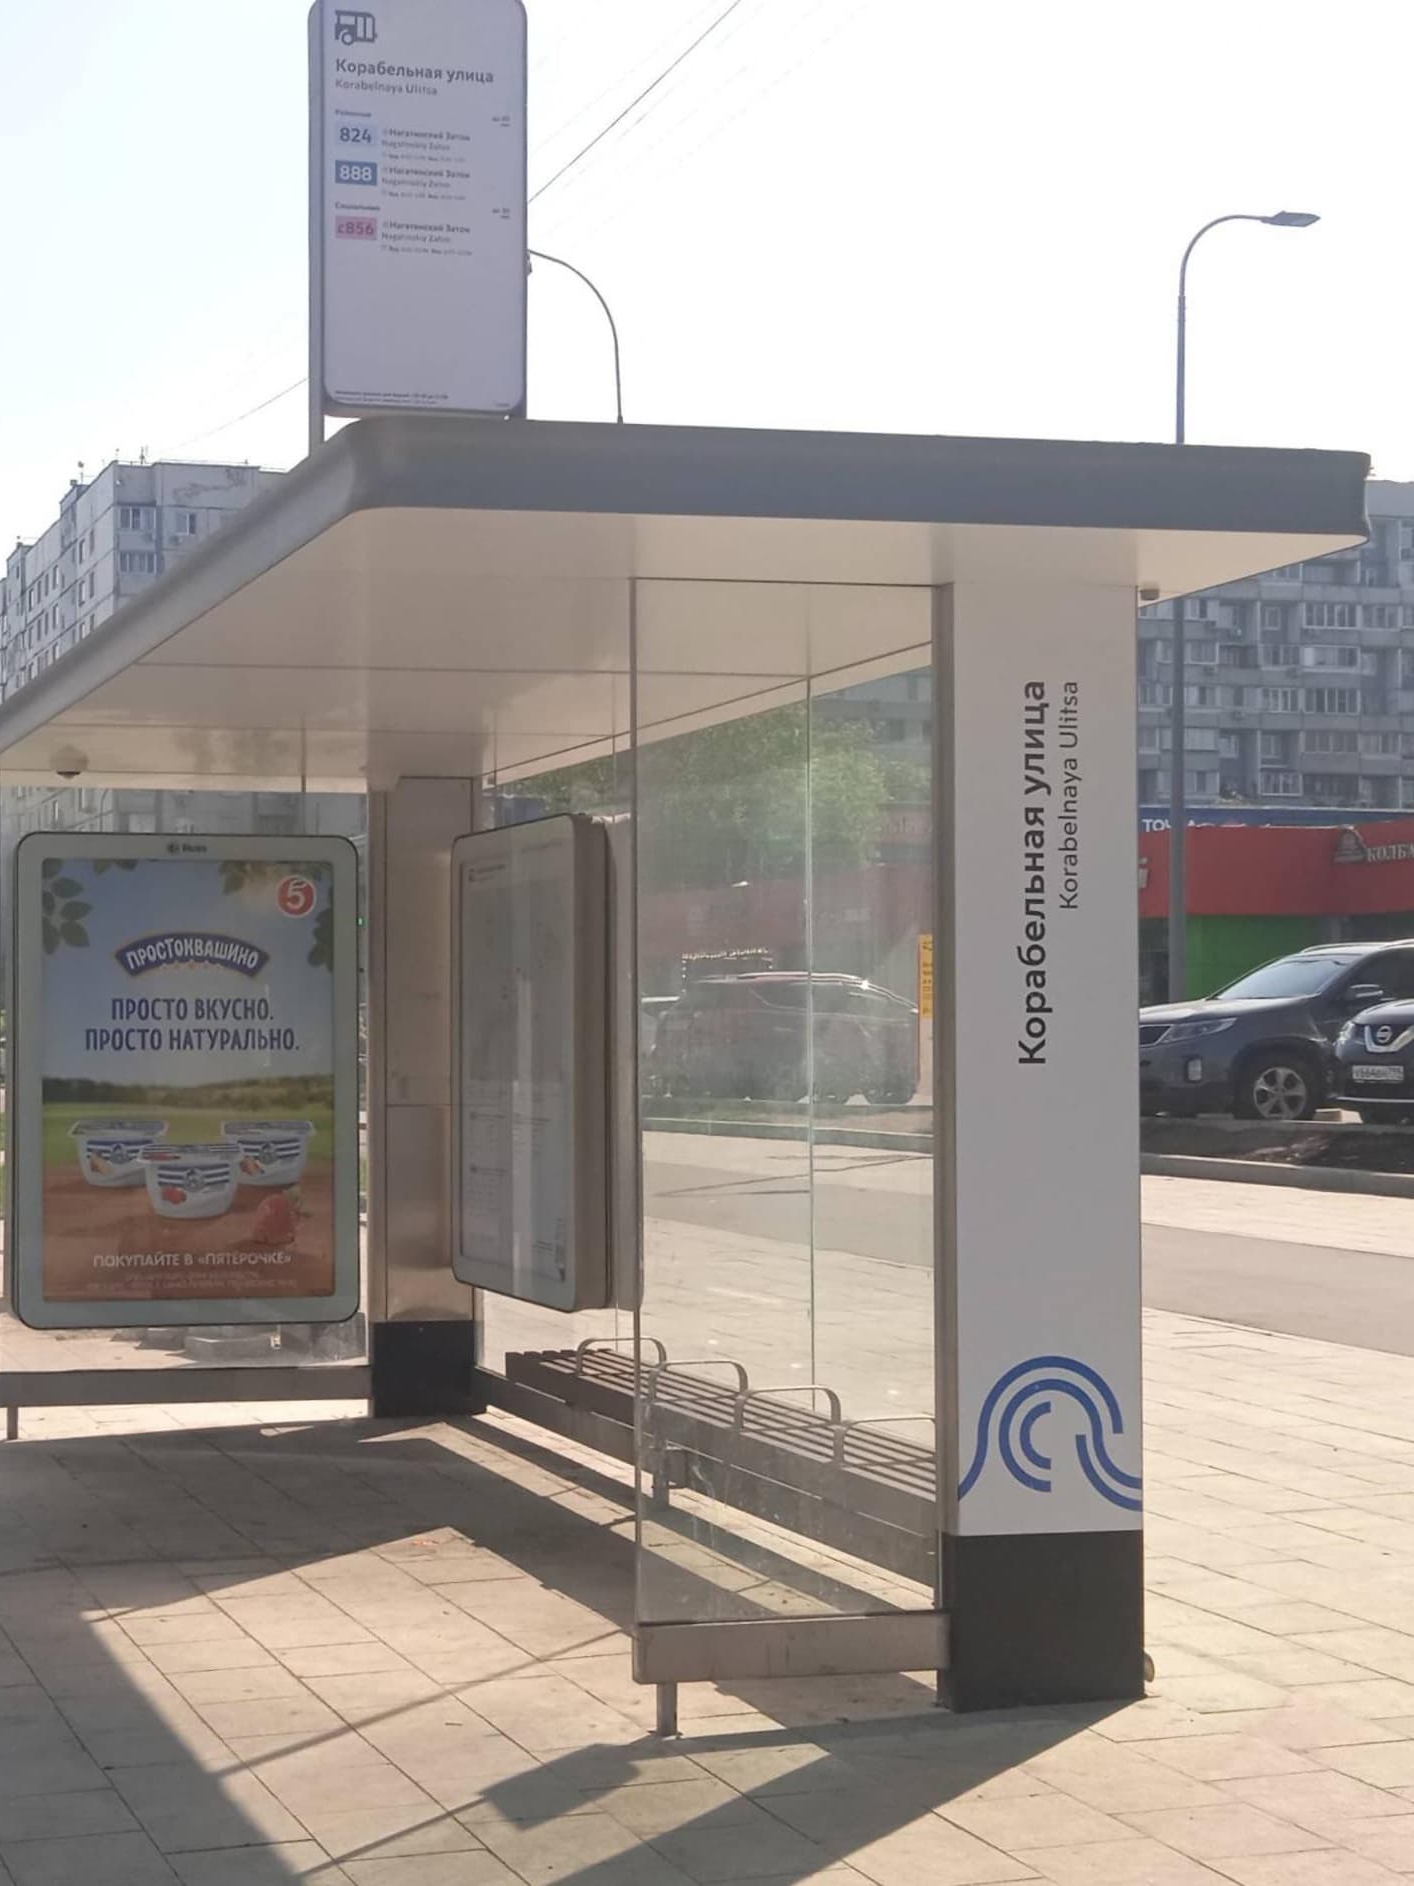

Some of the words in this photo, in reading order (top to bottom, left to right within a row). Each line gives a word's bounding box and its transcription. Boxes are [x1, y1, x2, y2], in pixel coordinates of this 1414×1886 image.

[335, 58, 442, 80] Корабельная
[446, 69, 494, 84] улица
[335, 79, 403, 95] Korabelnaya
[406, 84, 438, 95] Ulitsa
[339, 127, 372, 143] 824
[339, 165, 372, 181] 888
[1058, 681, 1078, 748] Ulitsa
[1024, 680, 1052, 796] улица
[1057, 757, 1083, 909] Korabelnaya
[1017, 807, 1053, 1064] Корабельная
[126, 937, 259, 970] ПРОСТОКВАШИНО
[111, 998, 188, 1021] ПРОСТО
[194, 998, 274, 1021] ВКУСНО.
[85, 1028, 162, 1051] ПРОСТО
[169, 1028, 300, 1051] НАТУРАЛЬНО.
[93, 1252, 180, 1268] ПОКУПАЙТЕ
[184, 1254, 194, 1266] В
